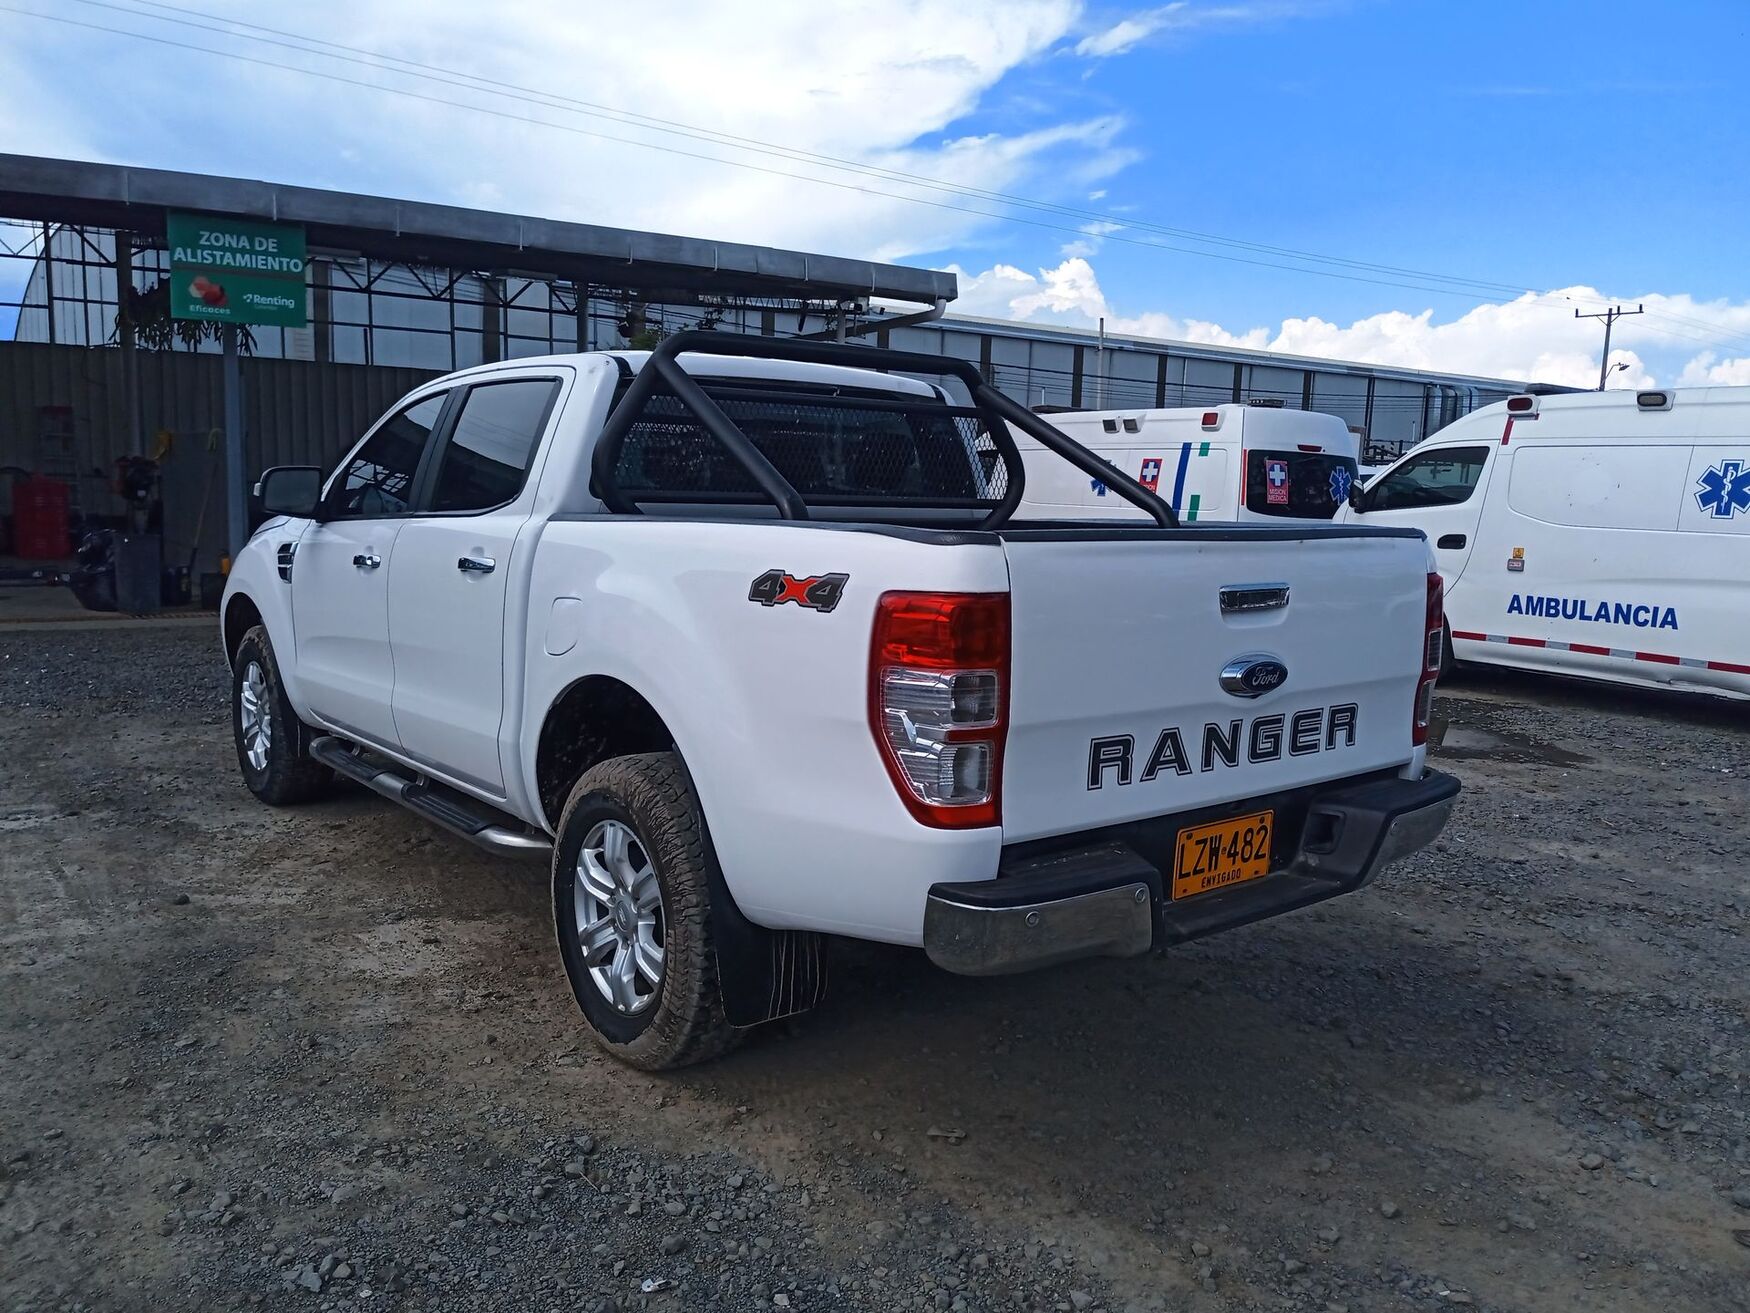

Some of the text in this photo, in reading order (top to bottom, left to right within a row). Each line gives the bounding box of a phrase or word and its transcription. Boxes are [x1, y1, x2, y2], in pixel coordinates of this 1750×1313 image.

[199, 231, 278, 252] ZONA DE
[173, 247, 303, 272] ALISTAMIENTO
[253, 294, 295, 308] Renting
[1507, 594, 1678, 630] AMBULANCIA
[1252, 666, 1280, 686] Ford
[1087, 703, 1358, 791] RANGER
[1201, 868, 1241, 888] ENVIGADO
